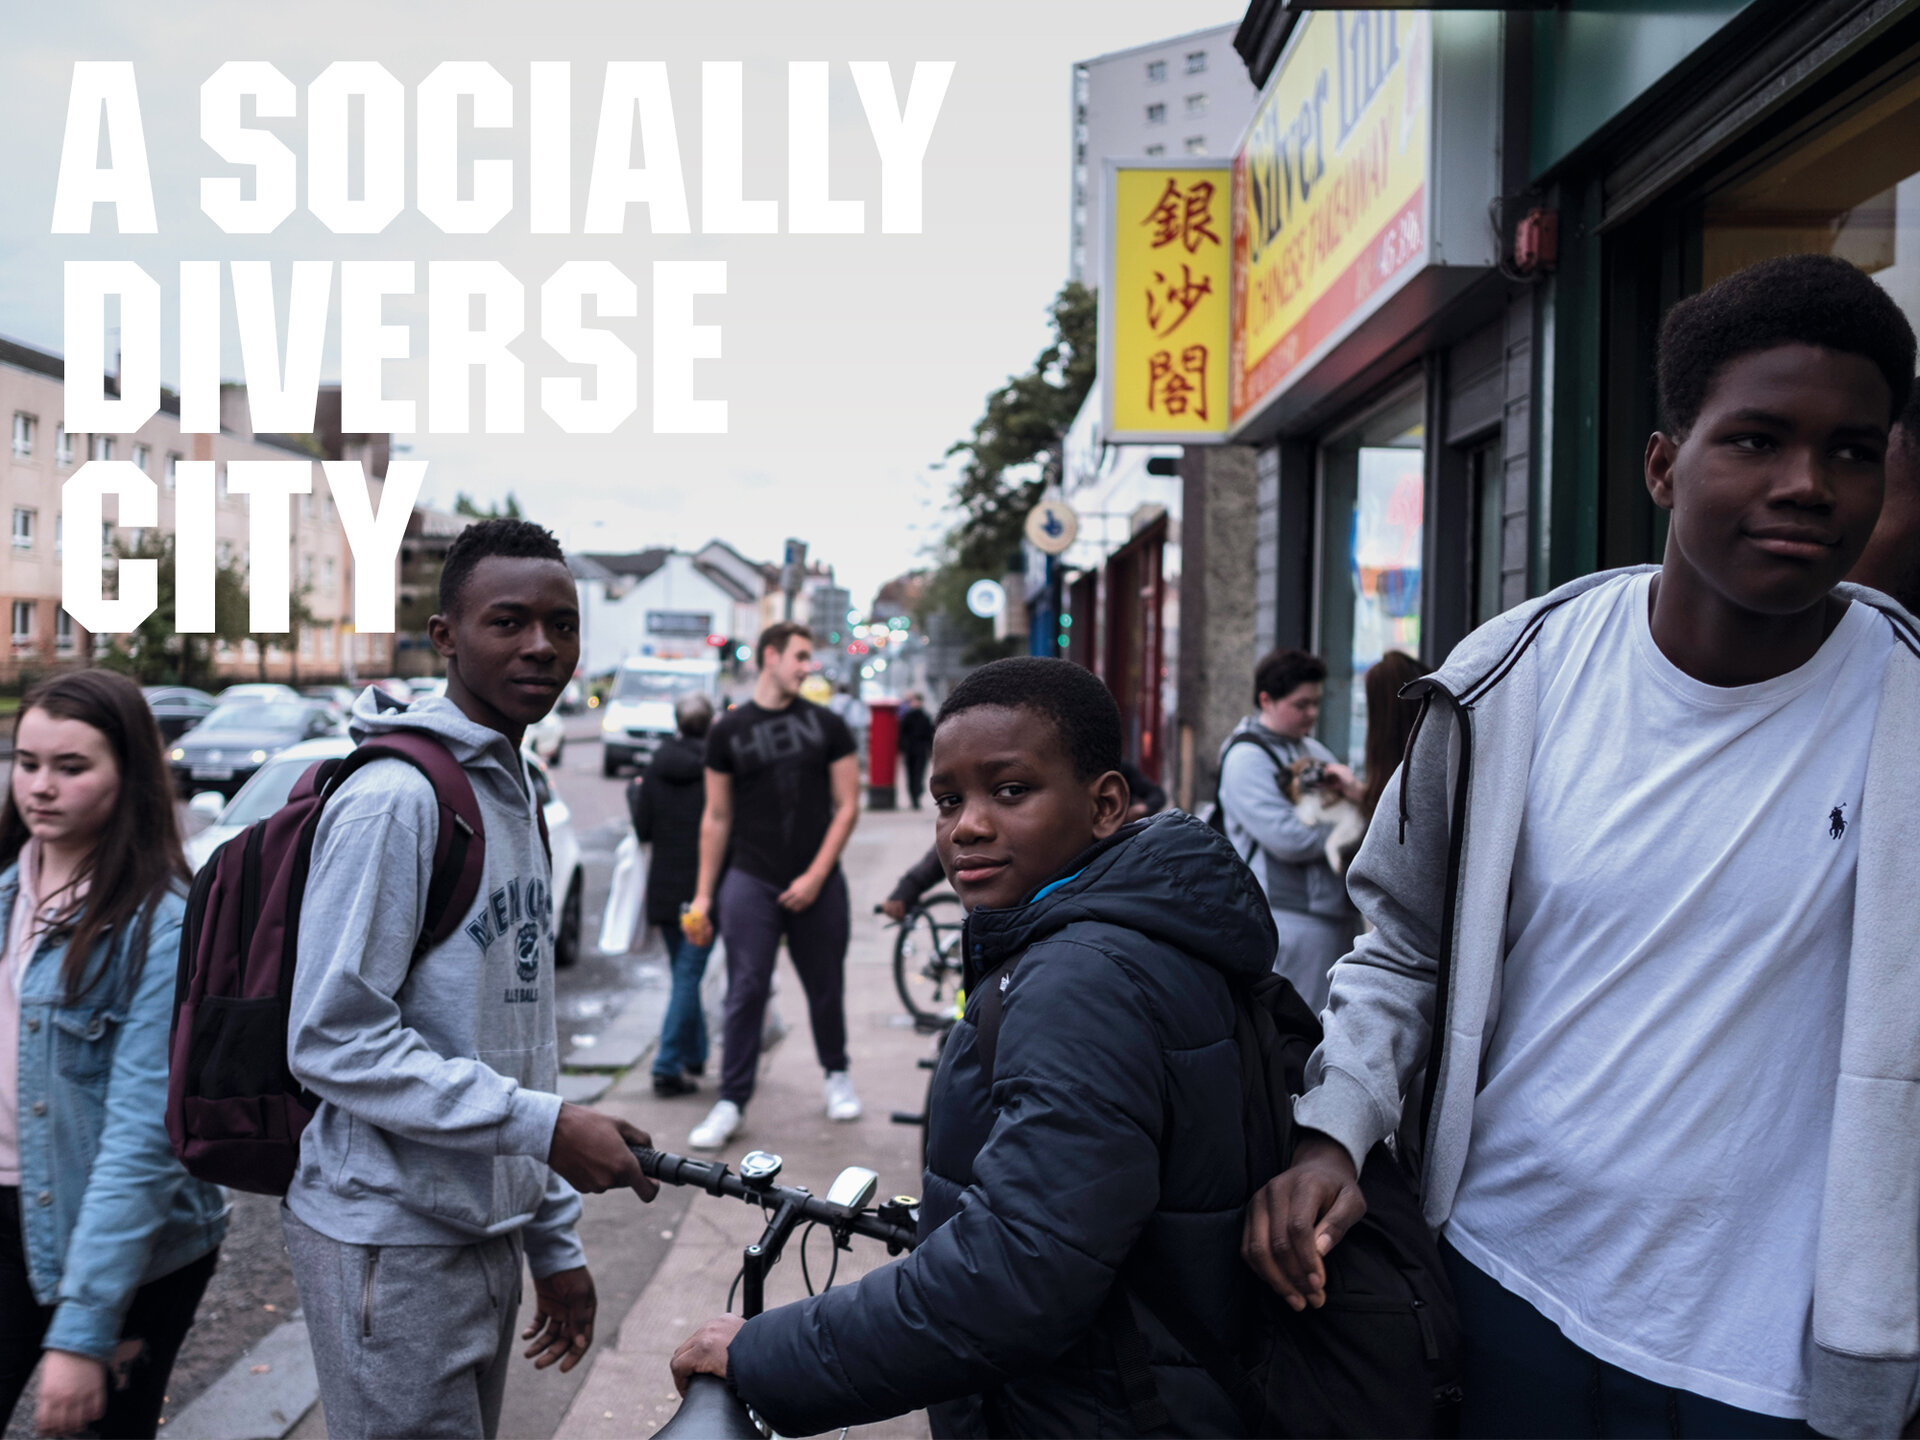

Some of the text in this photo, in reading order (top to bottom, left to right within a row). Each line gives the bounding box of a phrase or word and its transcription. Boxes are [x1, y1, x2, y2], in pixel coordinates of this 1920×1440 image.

[1251, 64, 1329, 262] Silver
[1141, 178, 1221, 421] 銀沙閣
